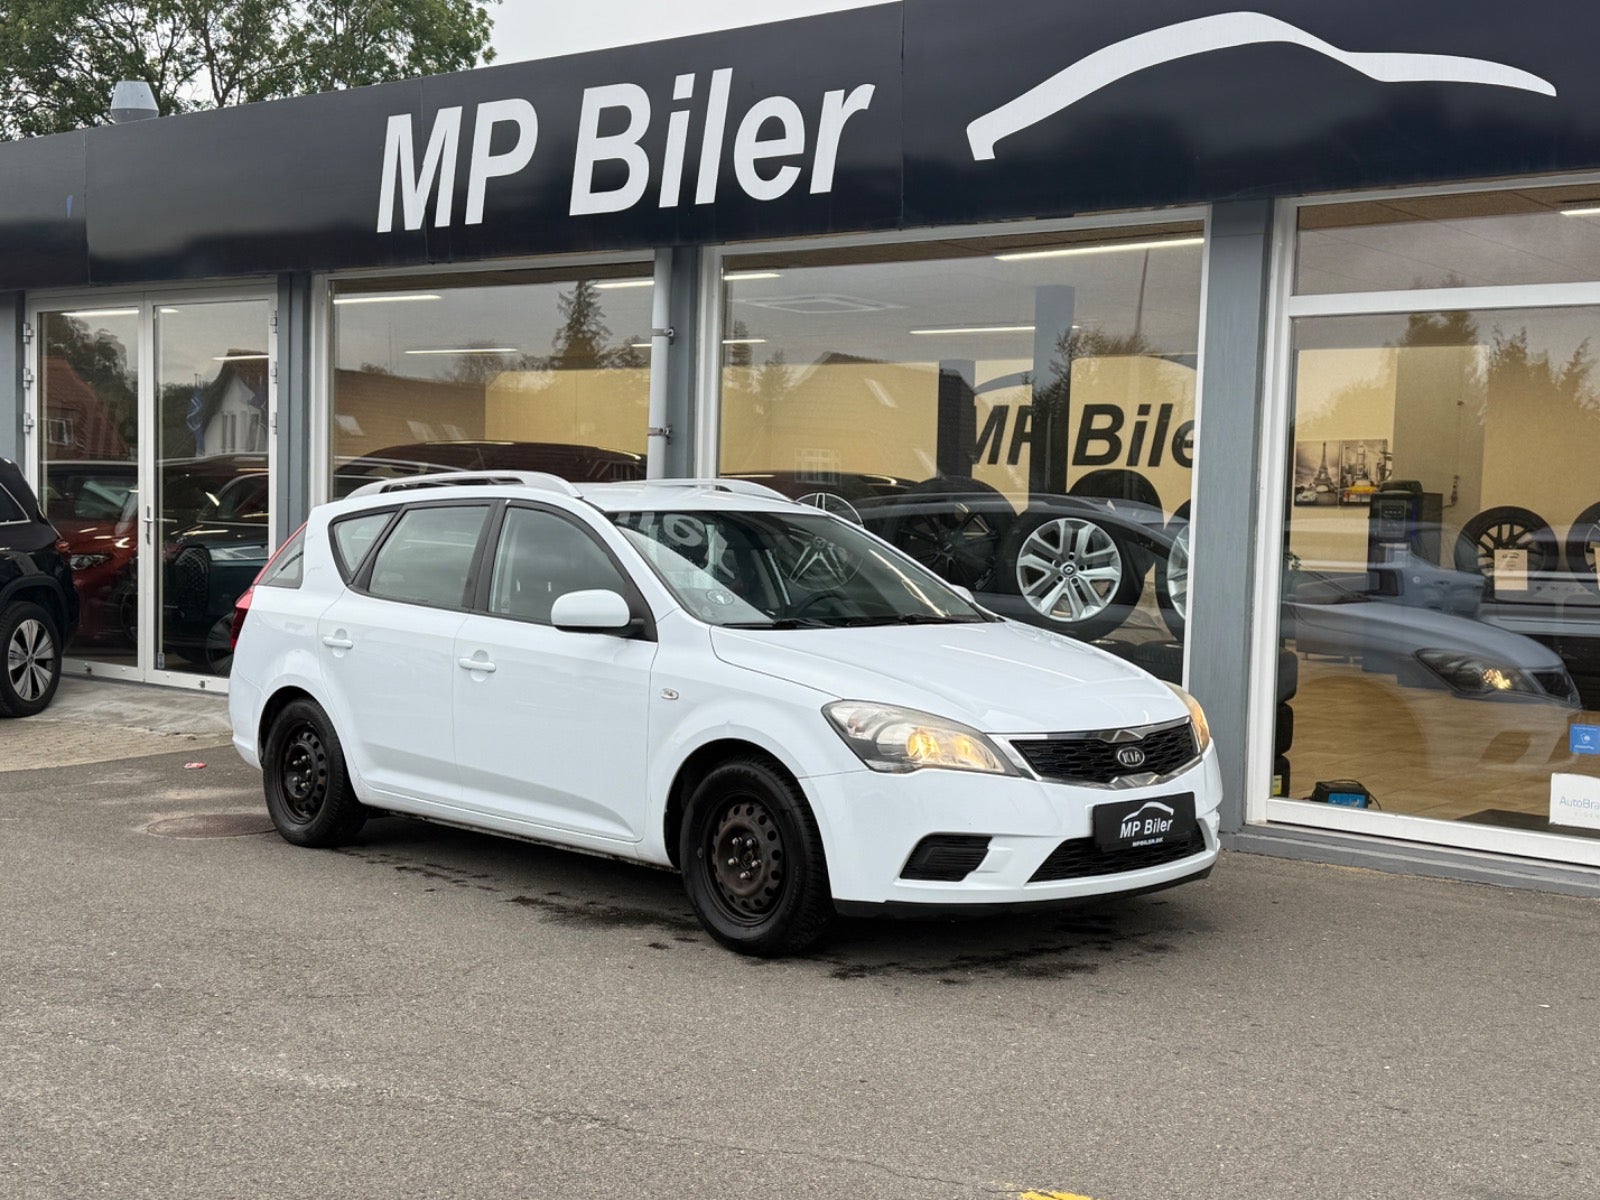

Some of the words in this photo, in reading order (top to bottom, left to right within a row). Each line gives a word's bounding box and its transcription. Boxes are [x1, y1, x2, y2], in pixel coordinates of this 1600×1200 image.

[377, 98, 538, 233] MP
[569, 67, 876, 216] Biler
[1120, 821, 1141, 838] MP
[1144, 818, 1173, 835] Biler
